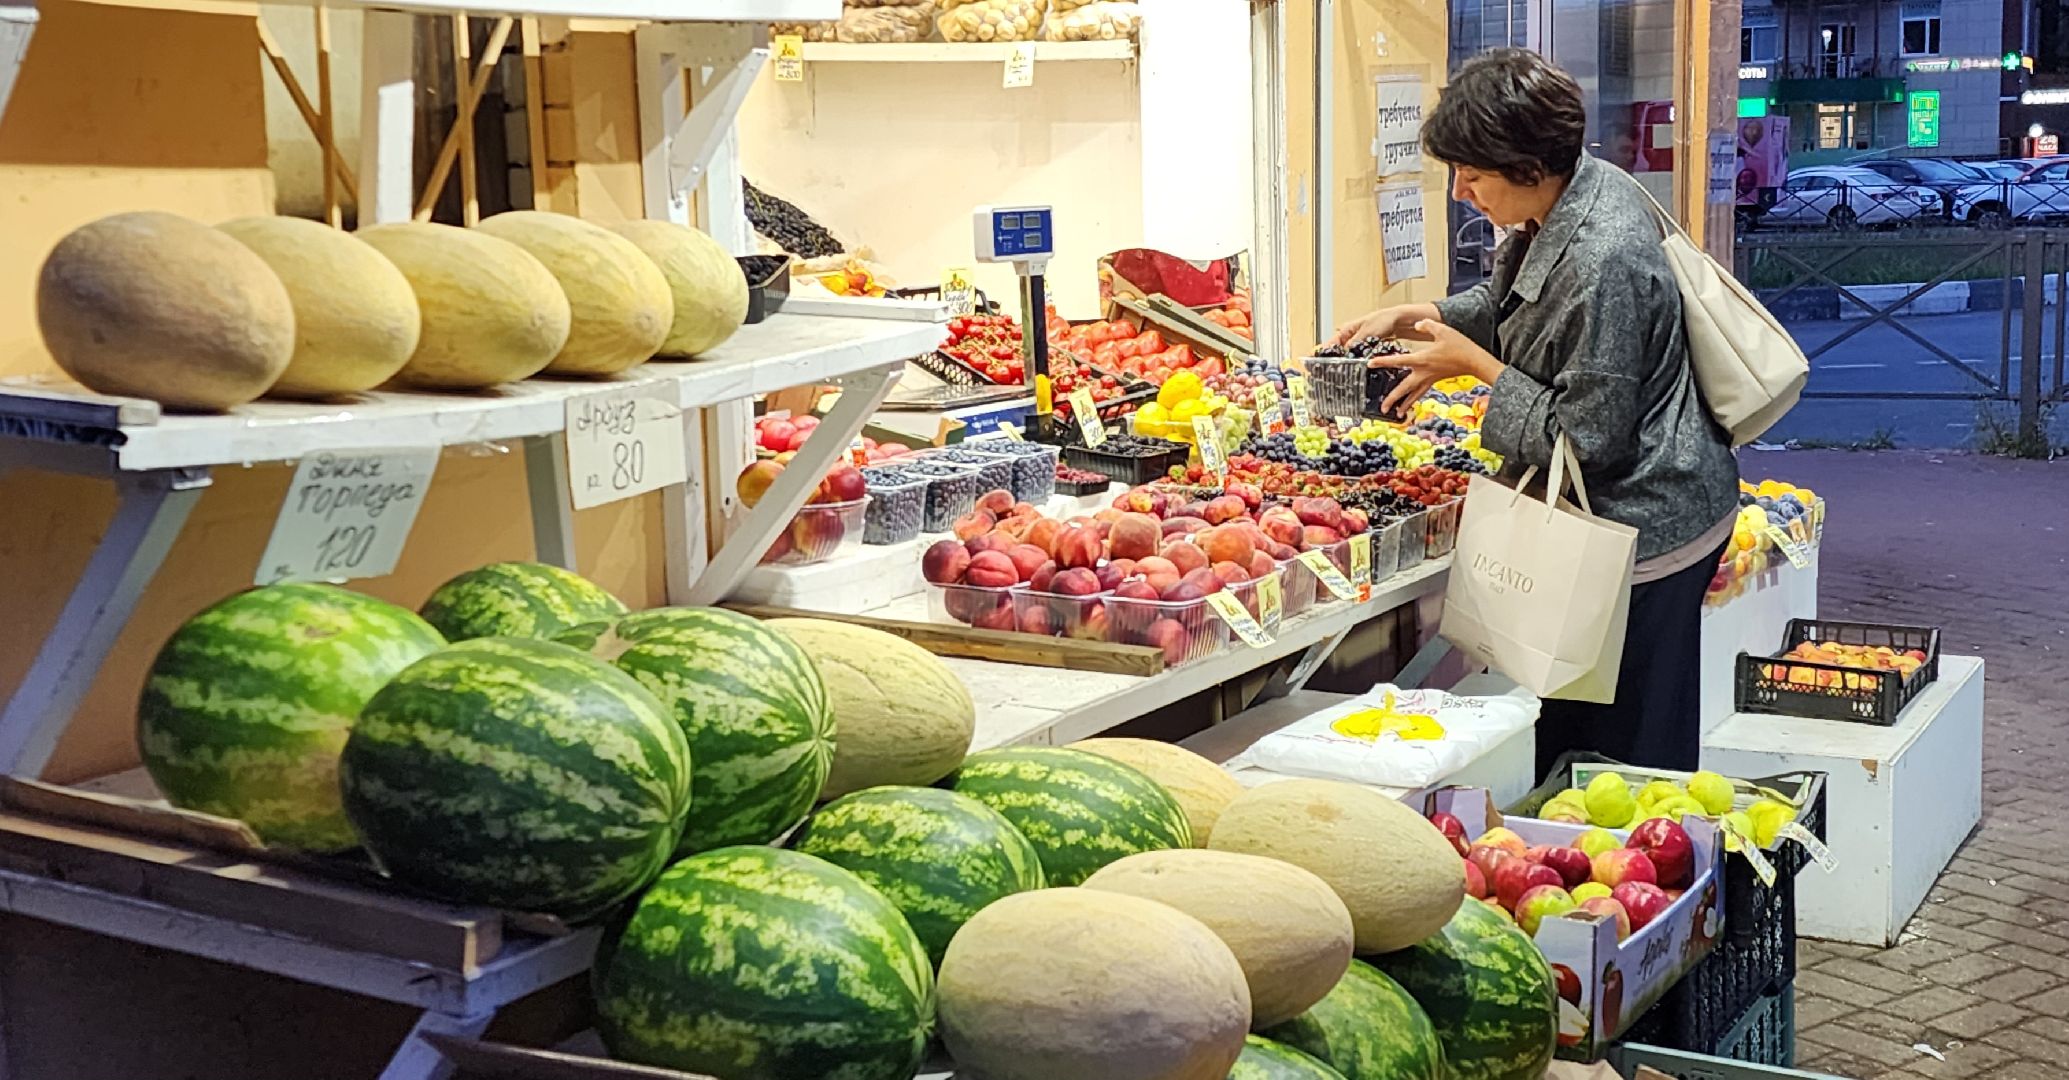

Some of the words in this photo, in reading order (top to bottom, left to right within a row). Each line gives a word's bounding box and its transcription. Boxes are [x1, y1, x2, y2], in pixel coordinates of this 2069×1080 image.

[1379, 98, 1422, 128] требуется
[1380, 202, 1424, 233] требуется
[612, 440, 645, 491] 80
[313, 524, 377, 573] 120
[1473, 553, 1534, 594] INCANTO
